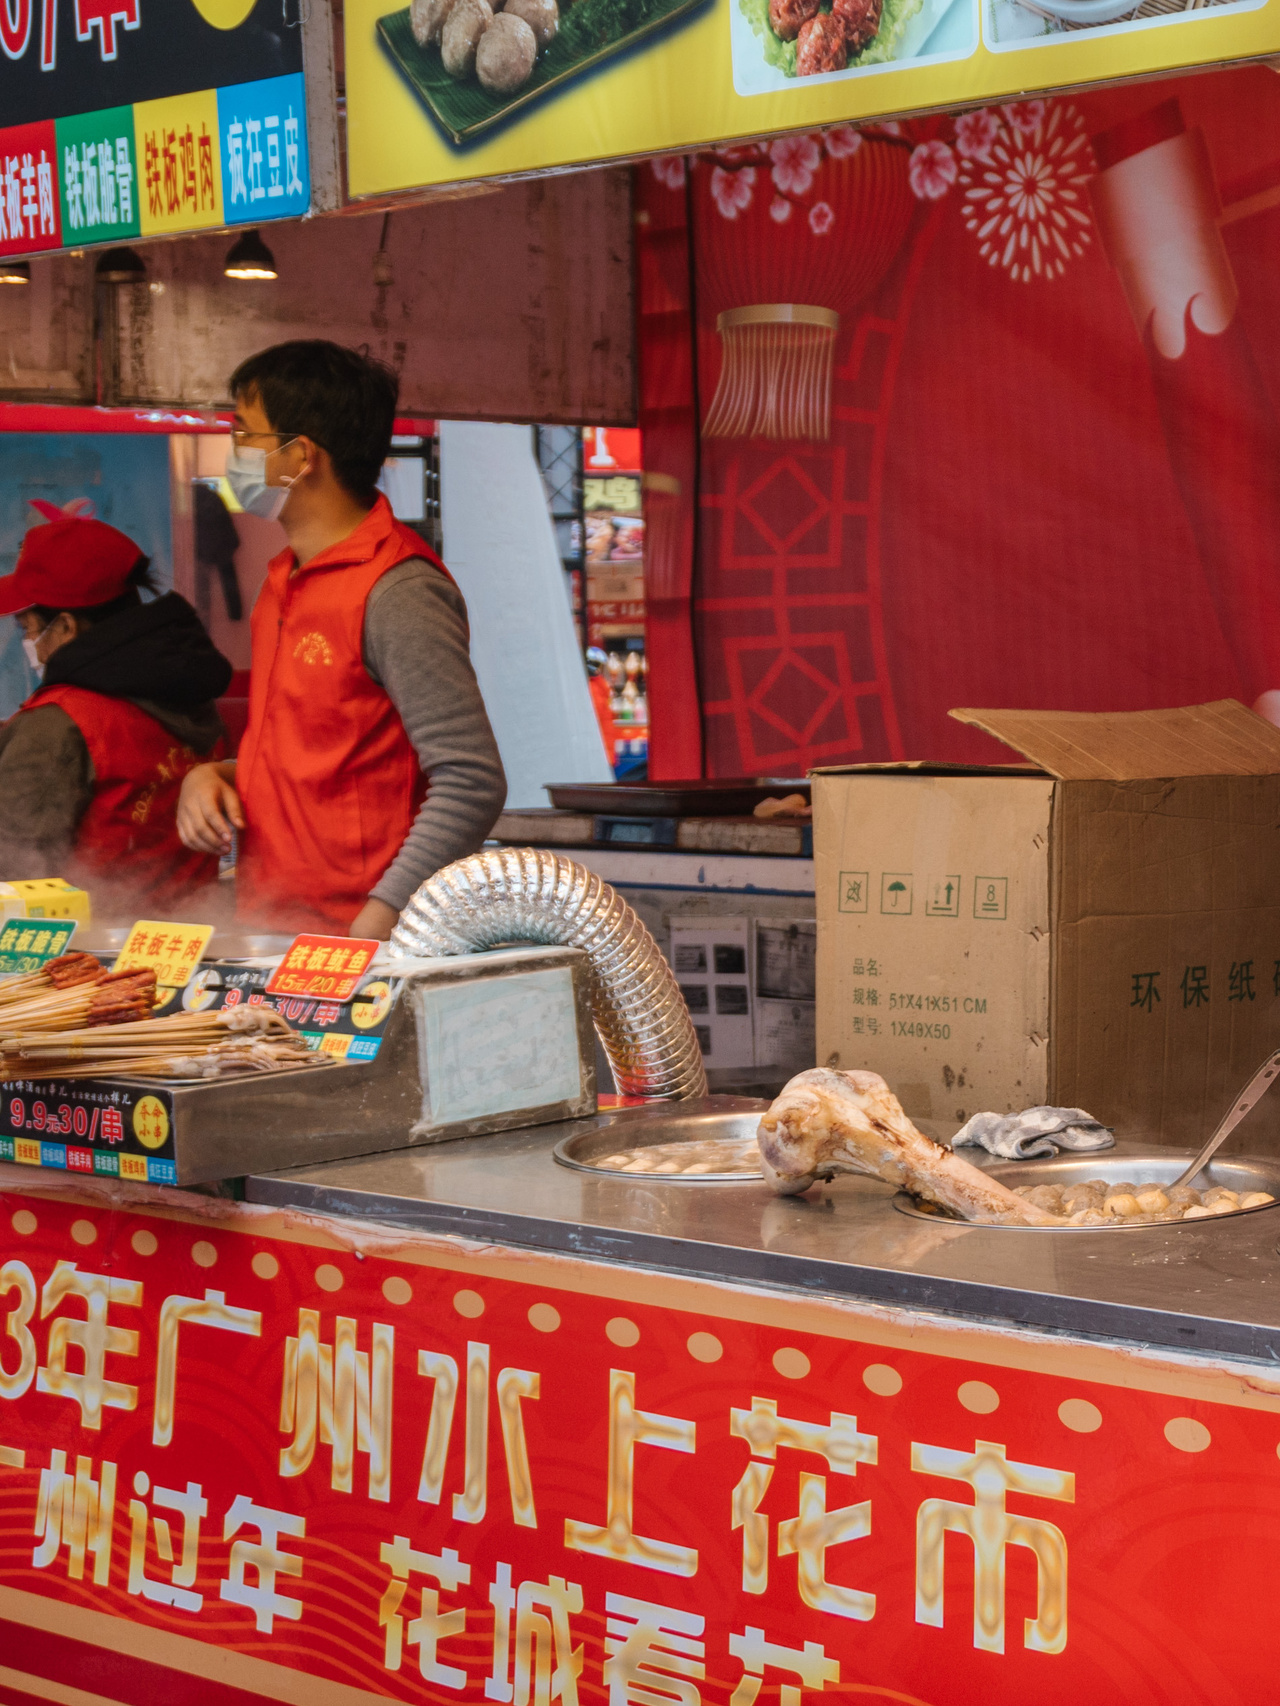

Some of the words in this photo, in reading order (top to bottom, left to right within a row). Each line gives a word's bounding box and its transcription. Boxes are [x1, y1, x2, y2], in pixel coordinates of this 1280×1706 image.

[64, 136, 133, 230] 铁板脆骨
[144, 121, 215, 218] 铁板鸡肉
[227, 104, 304, 206] 疯狂豆皮
[0, 928, 68, 956] 铁板脆骨
[129, 931, 203, 962] 铁板牛肉
[287, 945, 368, 975] 铁板鱿鱼
[10, 1097, 124, 1145] 9.9元30/串
[0, 1444, 306, 1634] 州过年
